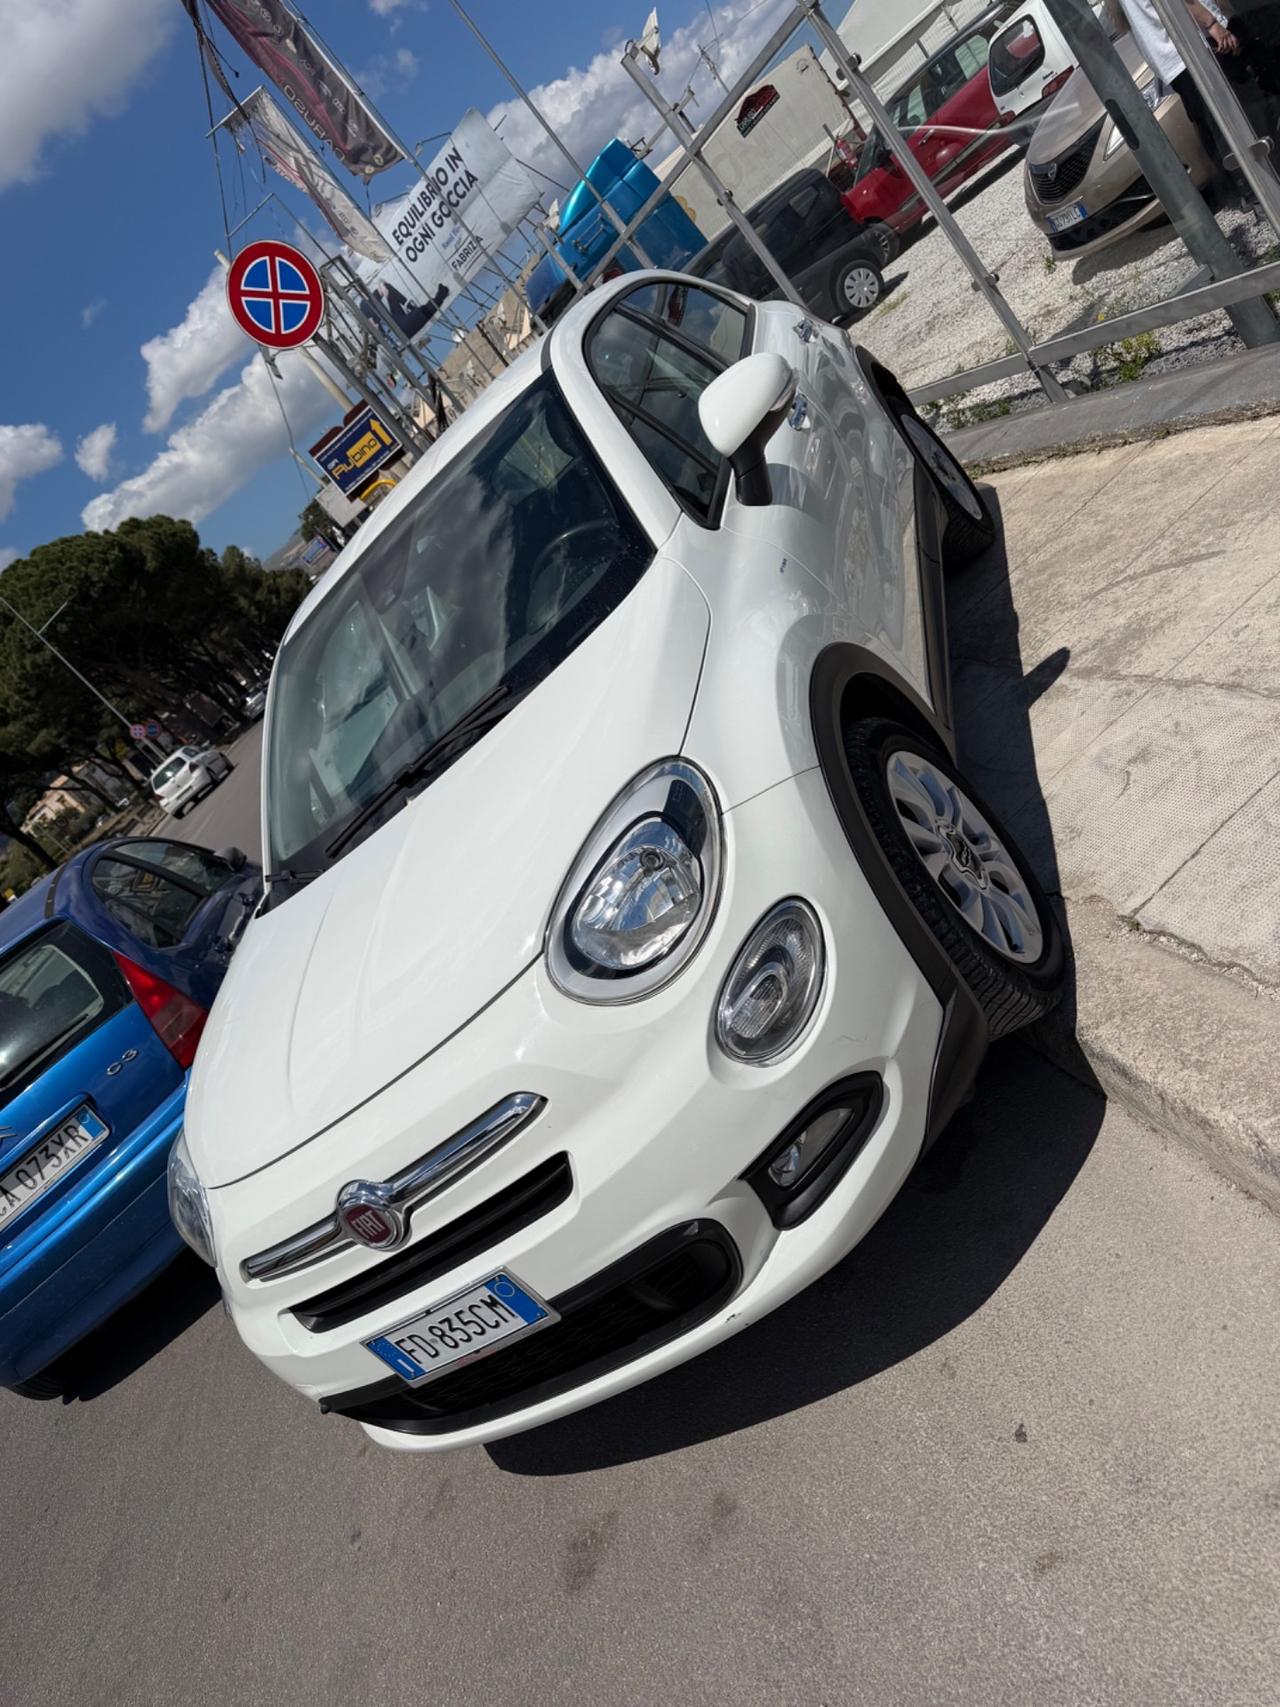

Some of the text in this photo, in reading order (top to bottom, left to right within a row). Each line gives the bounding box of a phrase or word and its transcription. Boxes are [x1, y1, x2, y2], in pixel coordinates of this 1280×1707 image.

[392, 147, 464, 246] EQUILIBRIO IN
[406, 222, 436, 262] OGNI
[431, 169, 478, 228] GOCCIA
[451, 235, 484, 271] FABRIZA
[15, 1125, 88, 1189] 073XR
[351, 1210, 385, 1239] FIAT
